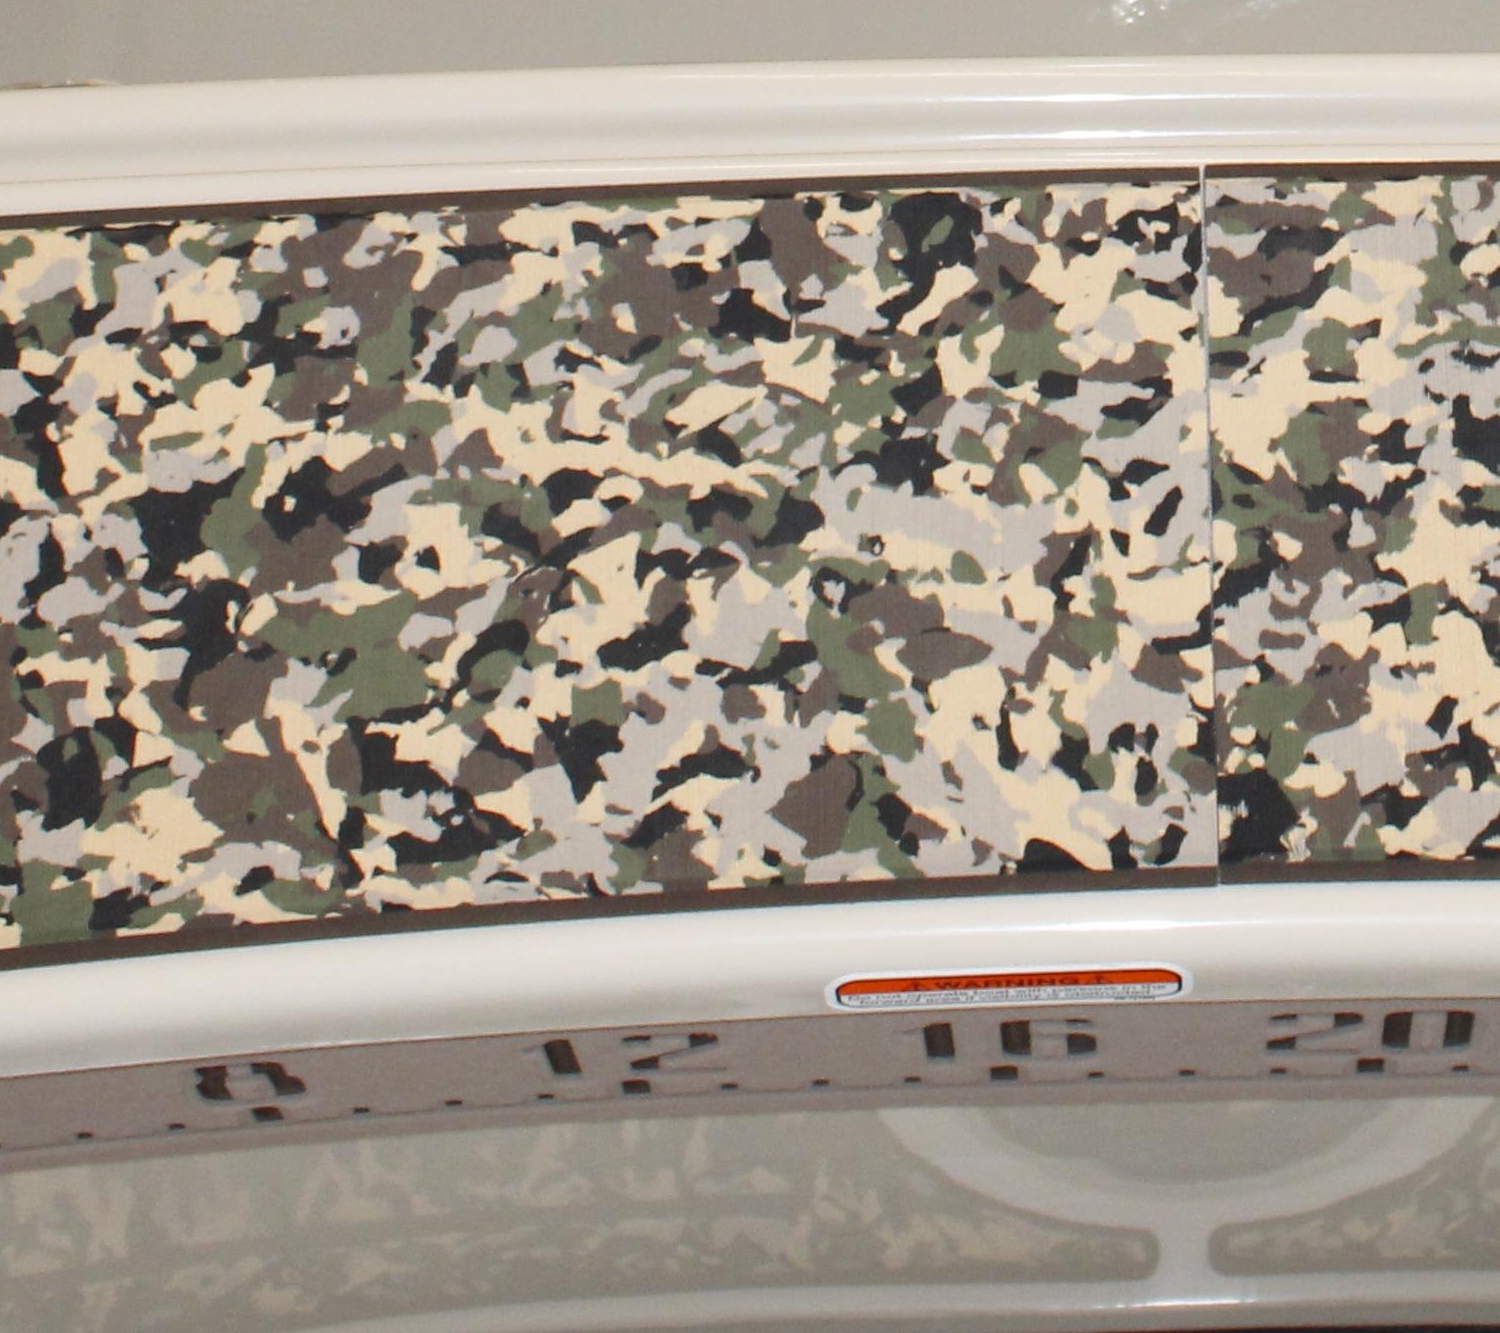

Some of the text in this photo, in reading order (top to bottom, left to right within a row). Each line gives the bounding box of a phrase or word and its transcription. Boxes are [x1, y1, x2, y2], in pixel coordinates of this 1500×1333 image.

[934, 977, 1079, 990] WARNING
[523, 1031, 729, 1075] 12
[1266, 1010, 1476, 1051] 20
